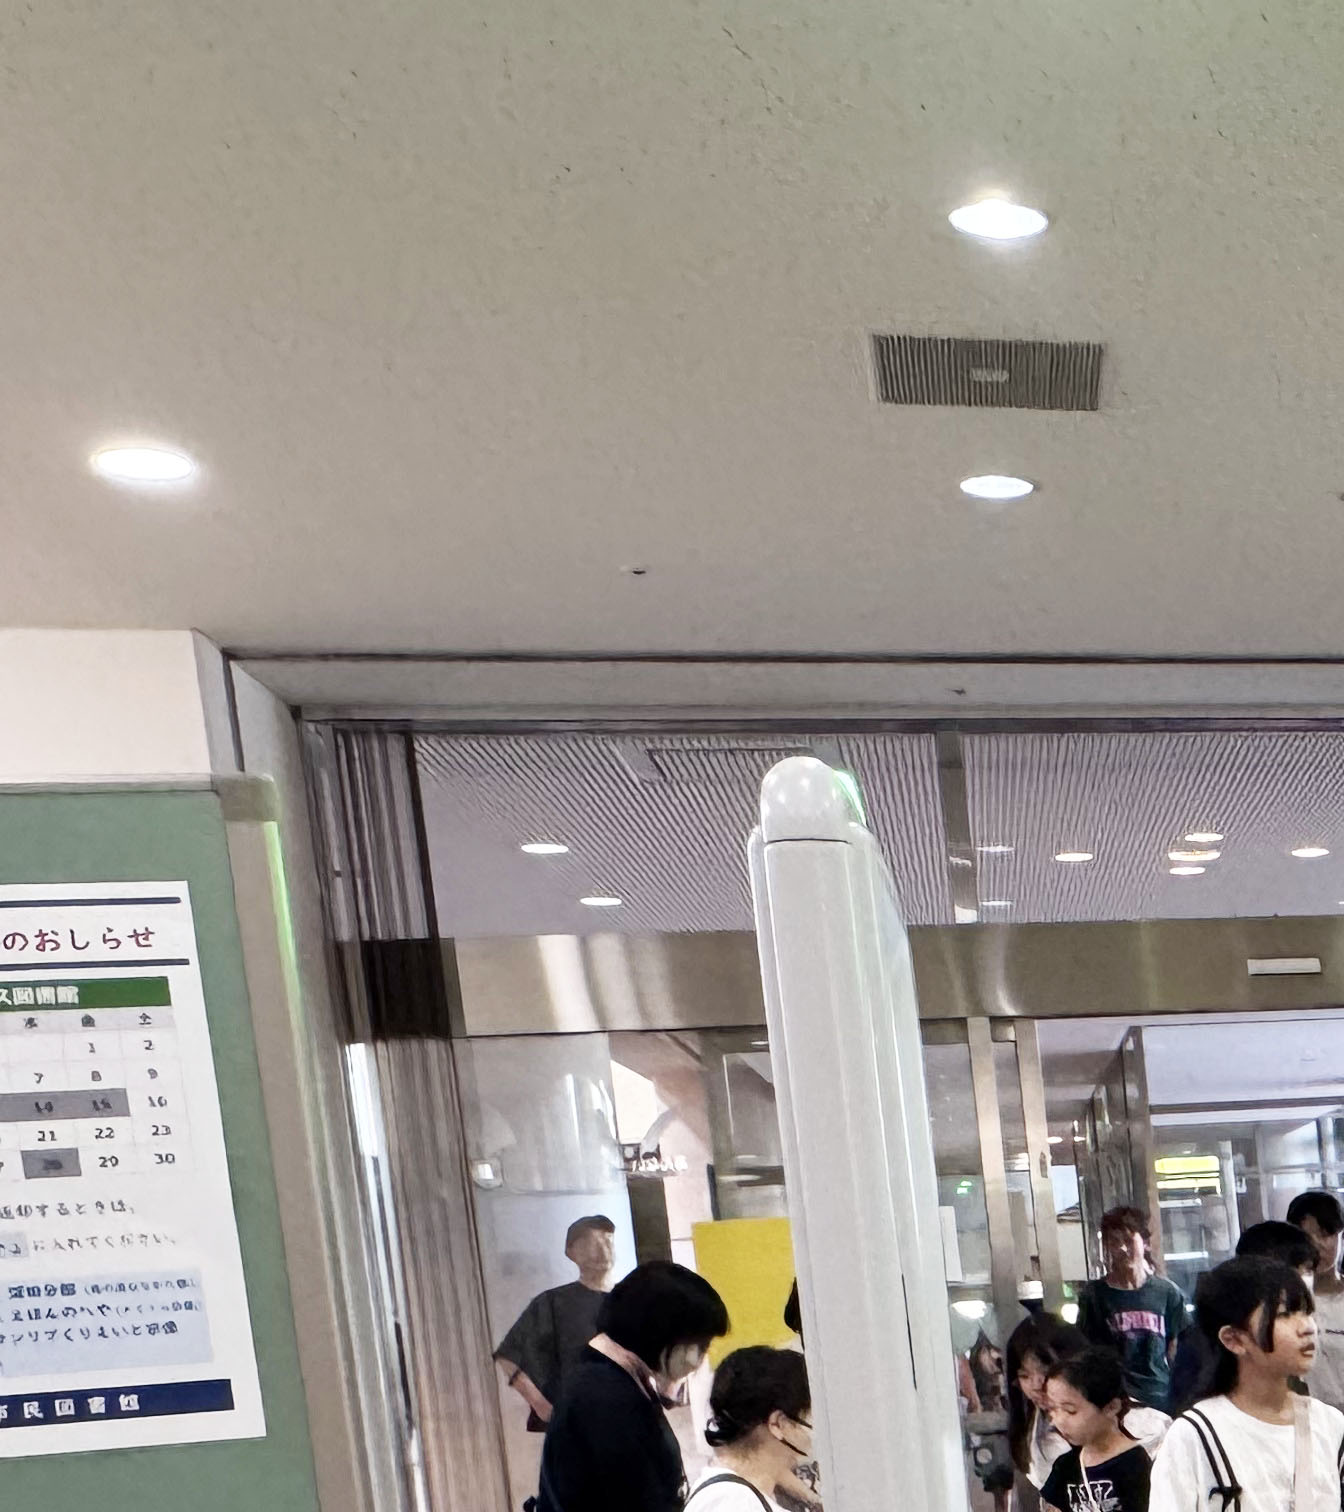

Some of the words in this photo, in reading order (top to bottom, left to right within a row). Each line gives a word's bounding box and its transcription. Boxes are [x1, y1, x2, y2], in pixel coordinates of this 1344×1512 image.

[2, 926, 156, 952] のおしらせ
[143, 1039, 154, 1051] 2
[94, 1127, 115, 1139] 22
